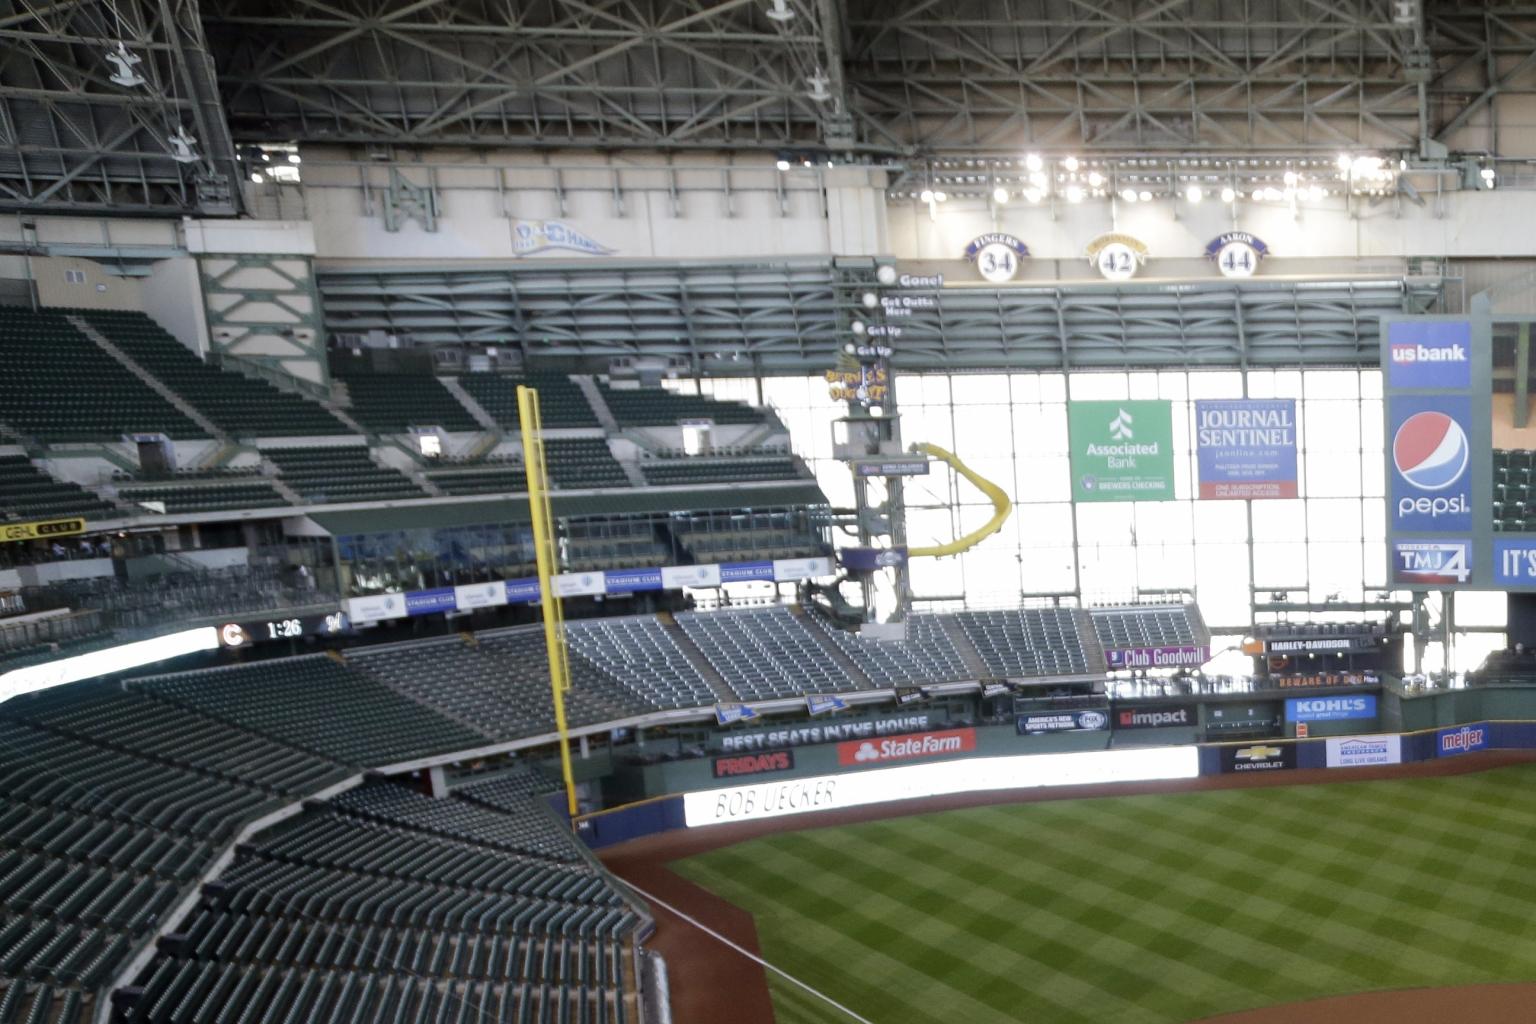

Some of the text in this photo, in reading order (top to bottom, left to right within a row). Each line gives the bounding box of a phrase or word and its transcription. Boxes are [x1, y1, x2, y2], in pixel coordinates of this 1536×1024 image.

[973, 233, 1019, 249] FINGERS
[1219, 233, 1254, 244] AARON
[983, 252, 1013, 273] 34
[1103, 252, 1132, 272] 42
[1222, 252, 1252, 272] 44
[900, 275, 943, 287] Gone!
[881, 297, 899, 307] Get
[1200, 409, 1293, 430] JOURNAL
[1200, 429, 1293, 447] SENTINEL
[1087, 442, 1158, 456] Associated
[1108, 456, 1136, 469] Bank
[1098, 481, 1131, 490] BREWERS
[1399, 494, 1465, 518] pepsi
[41, 521, 79, 533] CLUB
[267, 618, 302, 638] 1:26
[1271, 639, 1350, 651] HARLEY-DAVIDSON
[1124, 647, 1204, 667] Club Goodwill
[1280, 676, 1321, 688] BEWARE
[1326, 676, 1338, 685] OF
[1296, 699, 1366, 713] KOHL'S
[1132, 709, 1187, 726] impact
[723, 716, 928, 749] BEST SEATS IN THE HOUSE
[1025, 722, 1047, 731] SPORTS
[1442, 727, 1483, 751] meijer
[717, 751, 790, 776] FRIDAYS
[1234, 761, 1283, 771] CHEVROLET
[715, 779, 836, 819] BOB UECKER
